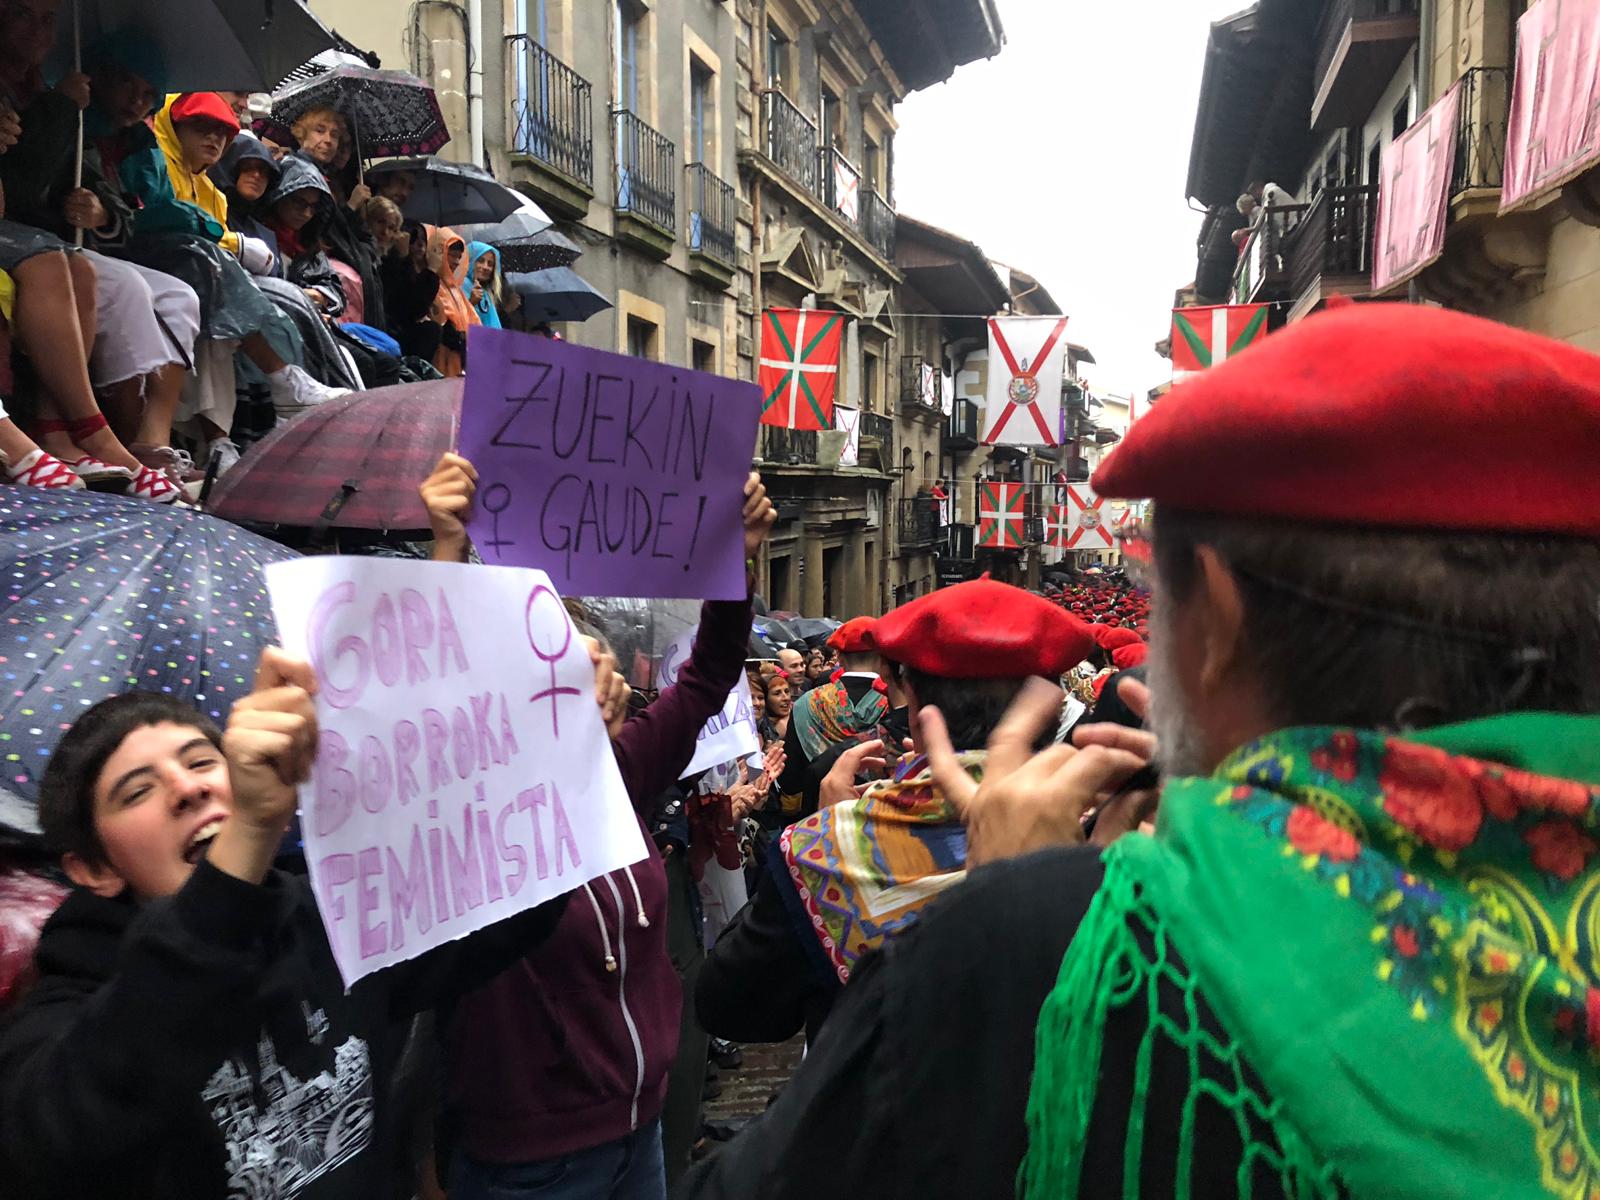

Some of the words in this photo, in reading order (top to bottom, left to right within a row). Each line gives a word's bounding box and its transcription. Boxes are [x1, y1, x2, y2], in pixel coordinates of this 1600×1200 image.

[540, 474, 707, 580] GAUDE!
[307, 581, 470, 708] GORA
[313, 691, 520, 837] BORROKA
